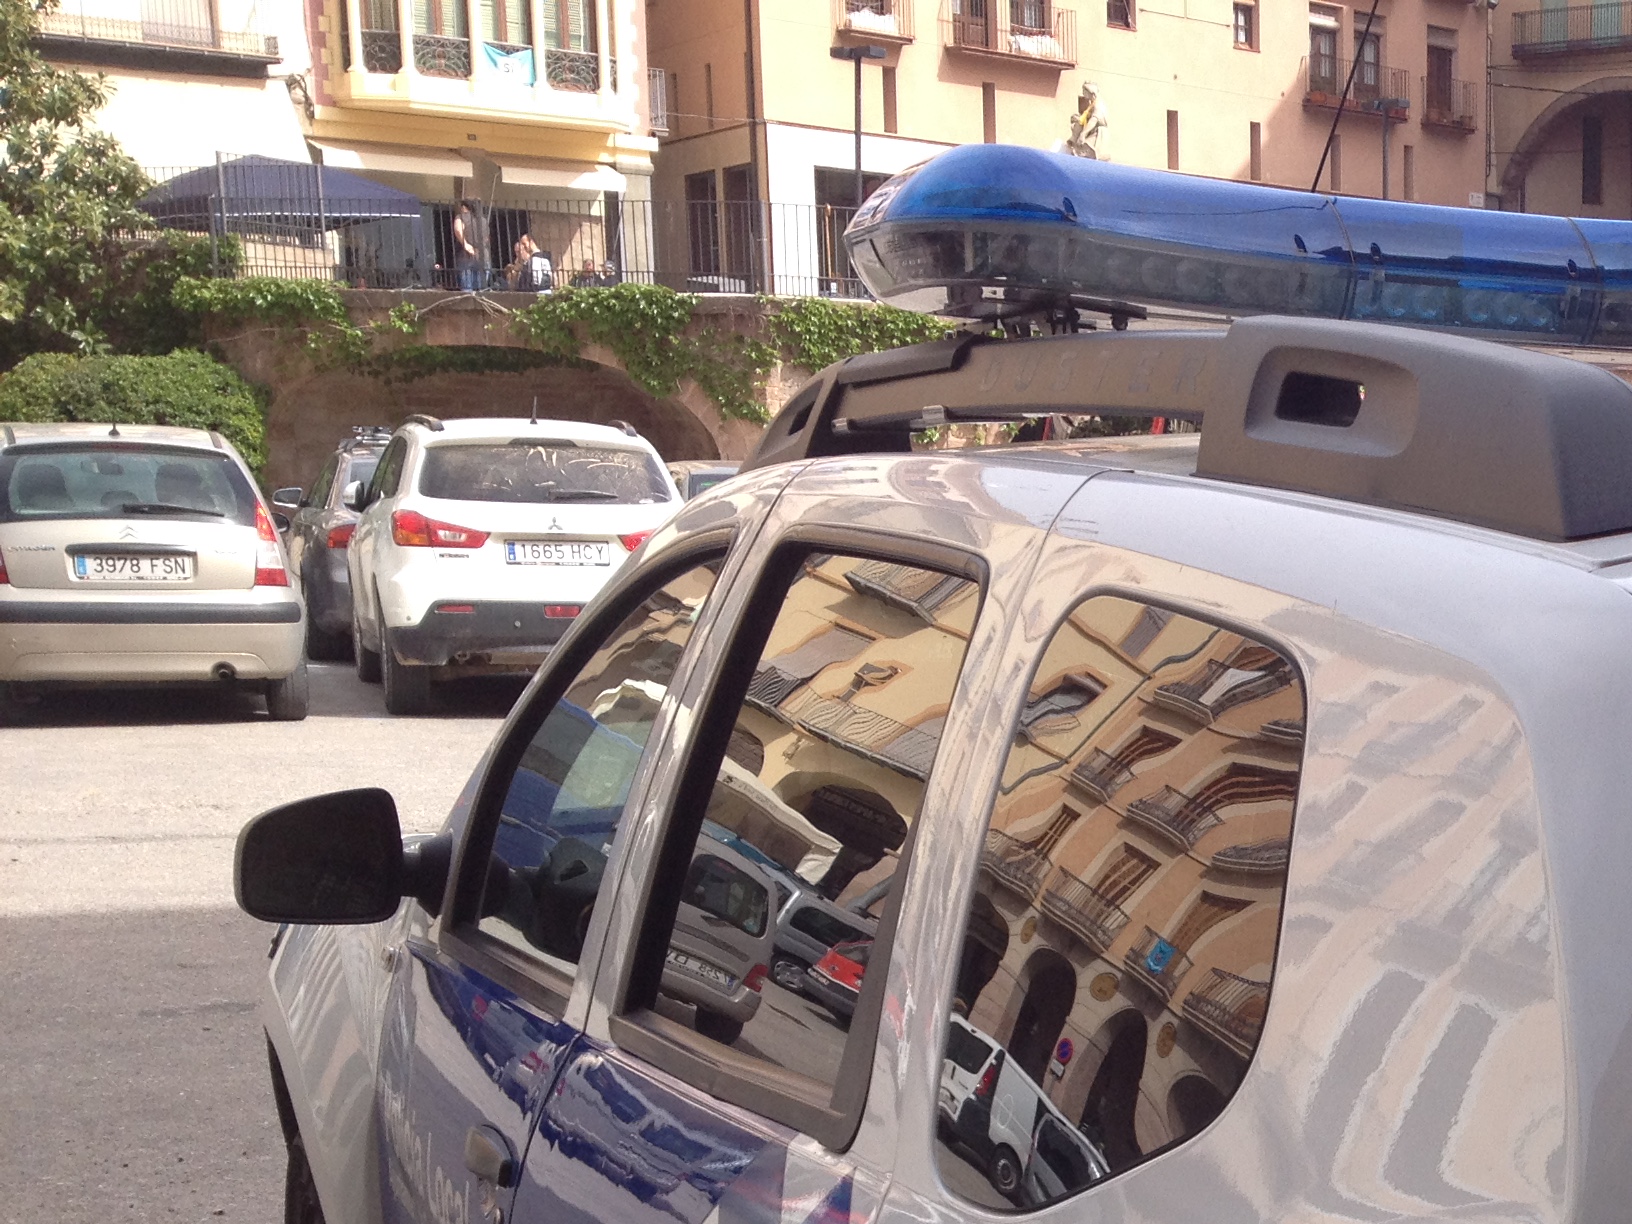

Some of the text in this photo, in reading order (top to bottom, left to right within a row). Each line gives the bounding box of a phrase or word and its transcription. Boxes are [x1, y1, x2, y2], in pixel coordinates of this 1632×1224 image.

[521, 543, 603, 560] 1665 HCY
[93, 556, 186, 574] 3978 FSN
